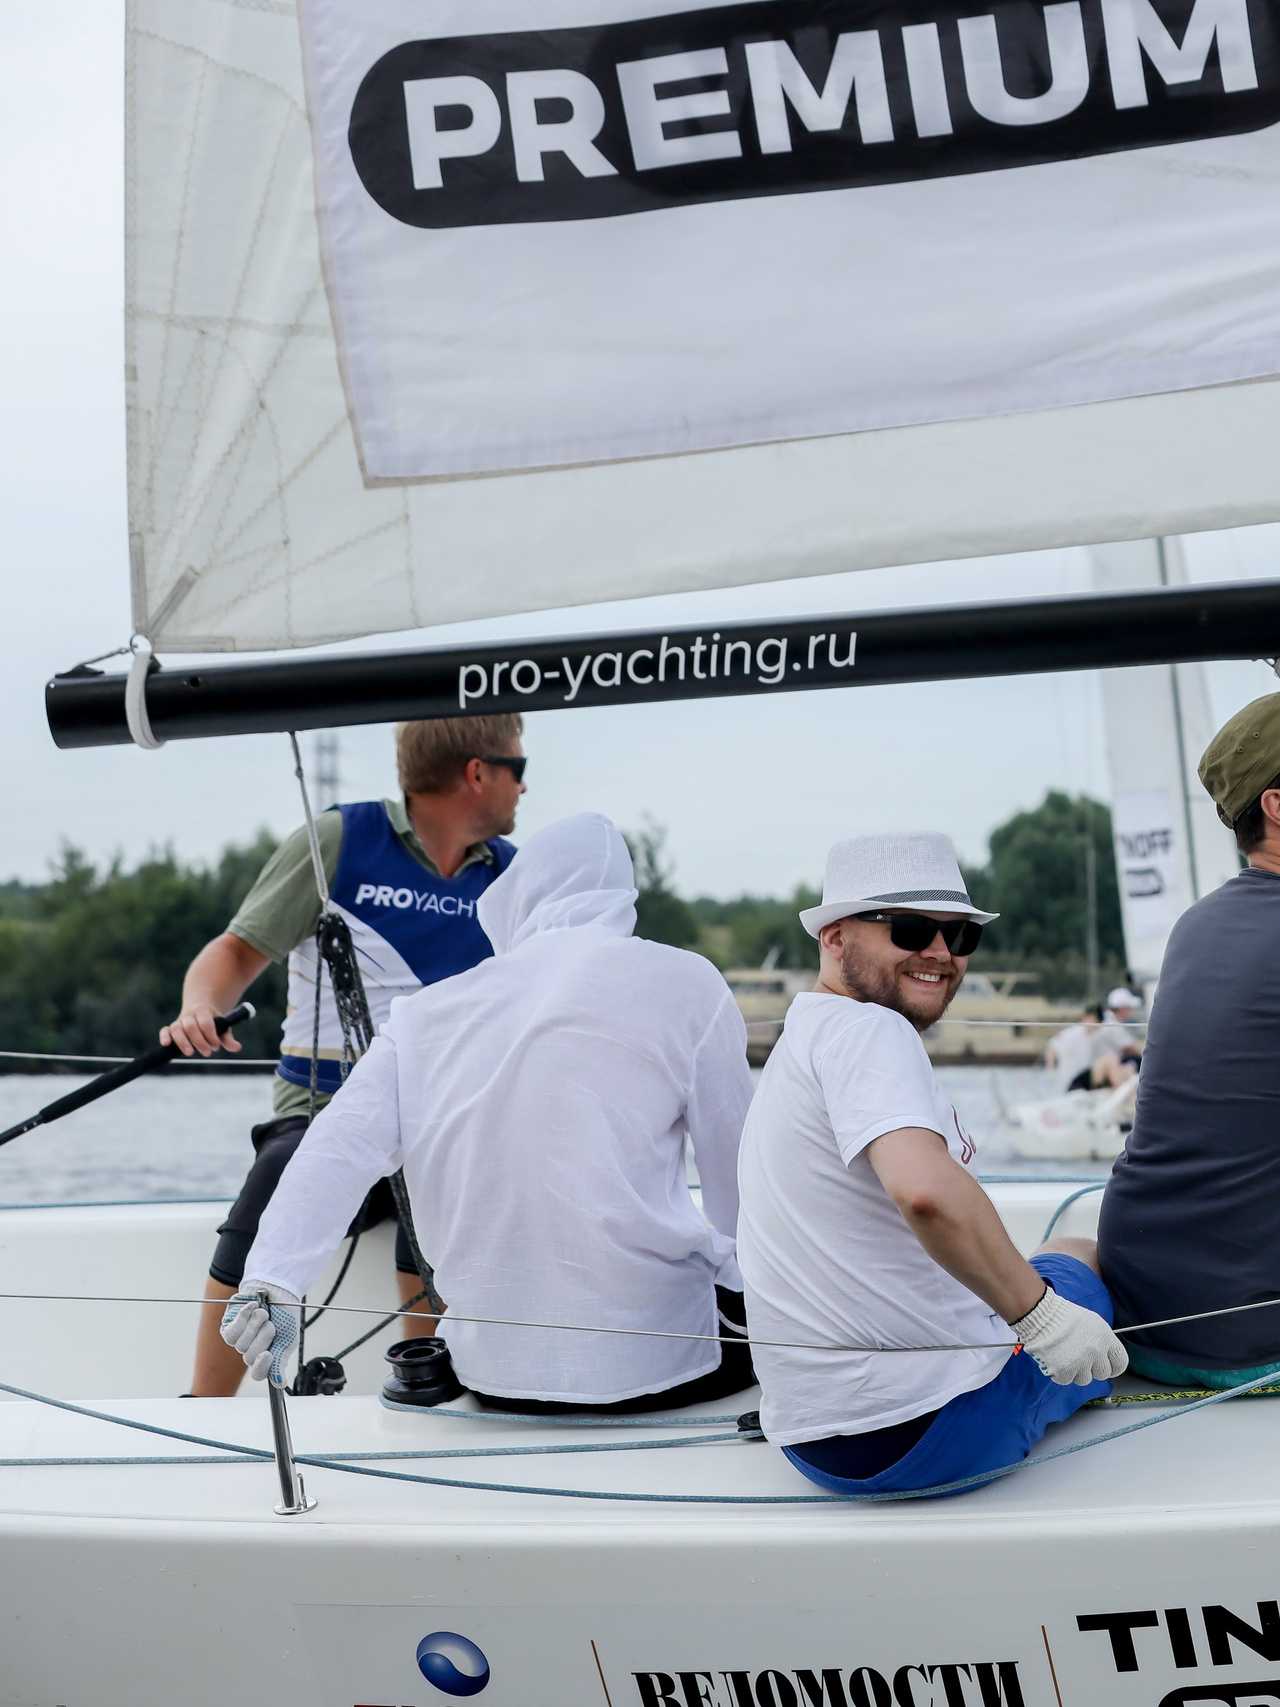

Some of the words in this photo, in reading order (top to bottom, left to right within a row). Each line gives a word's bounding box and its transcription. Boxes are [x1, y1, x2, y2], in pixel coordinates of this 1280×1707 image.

[403, 0, 1258, 190] PREMIUM
[458, 632, 858, 709] pro-yachting.ru
[355, 884, 477, 918] PROYACH
